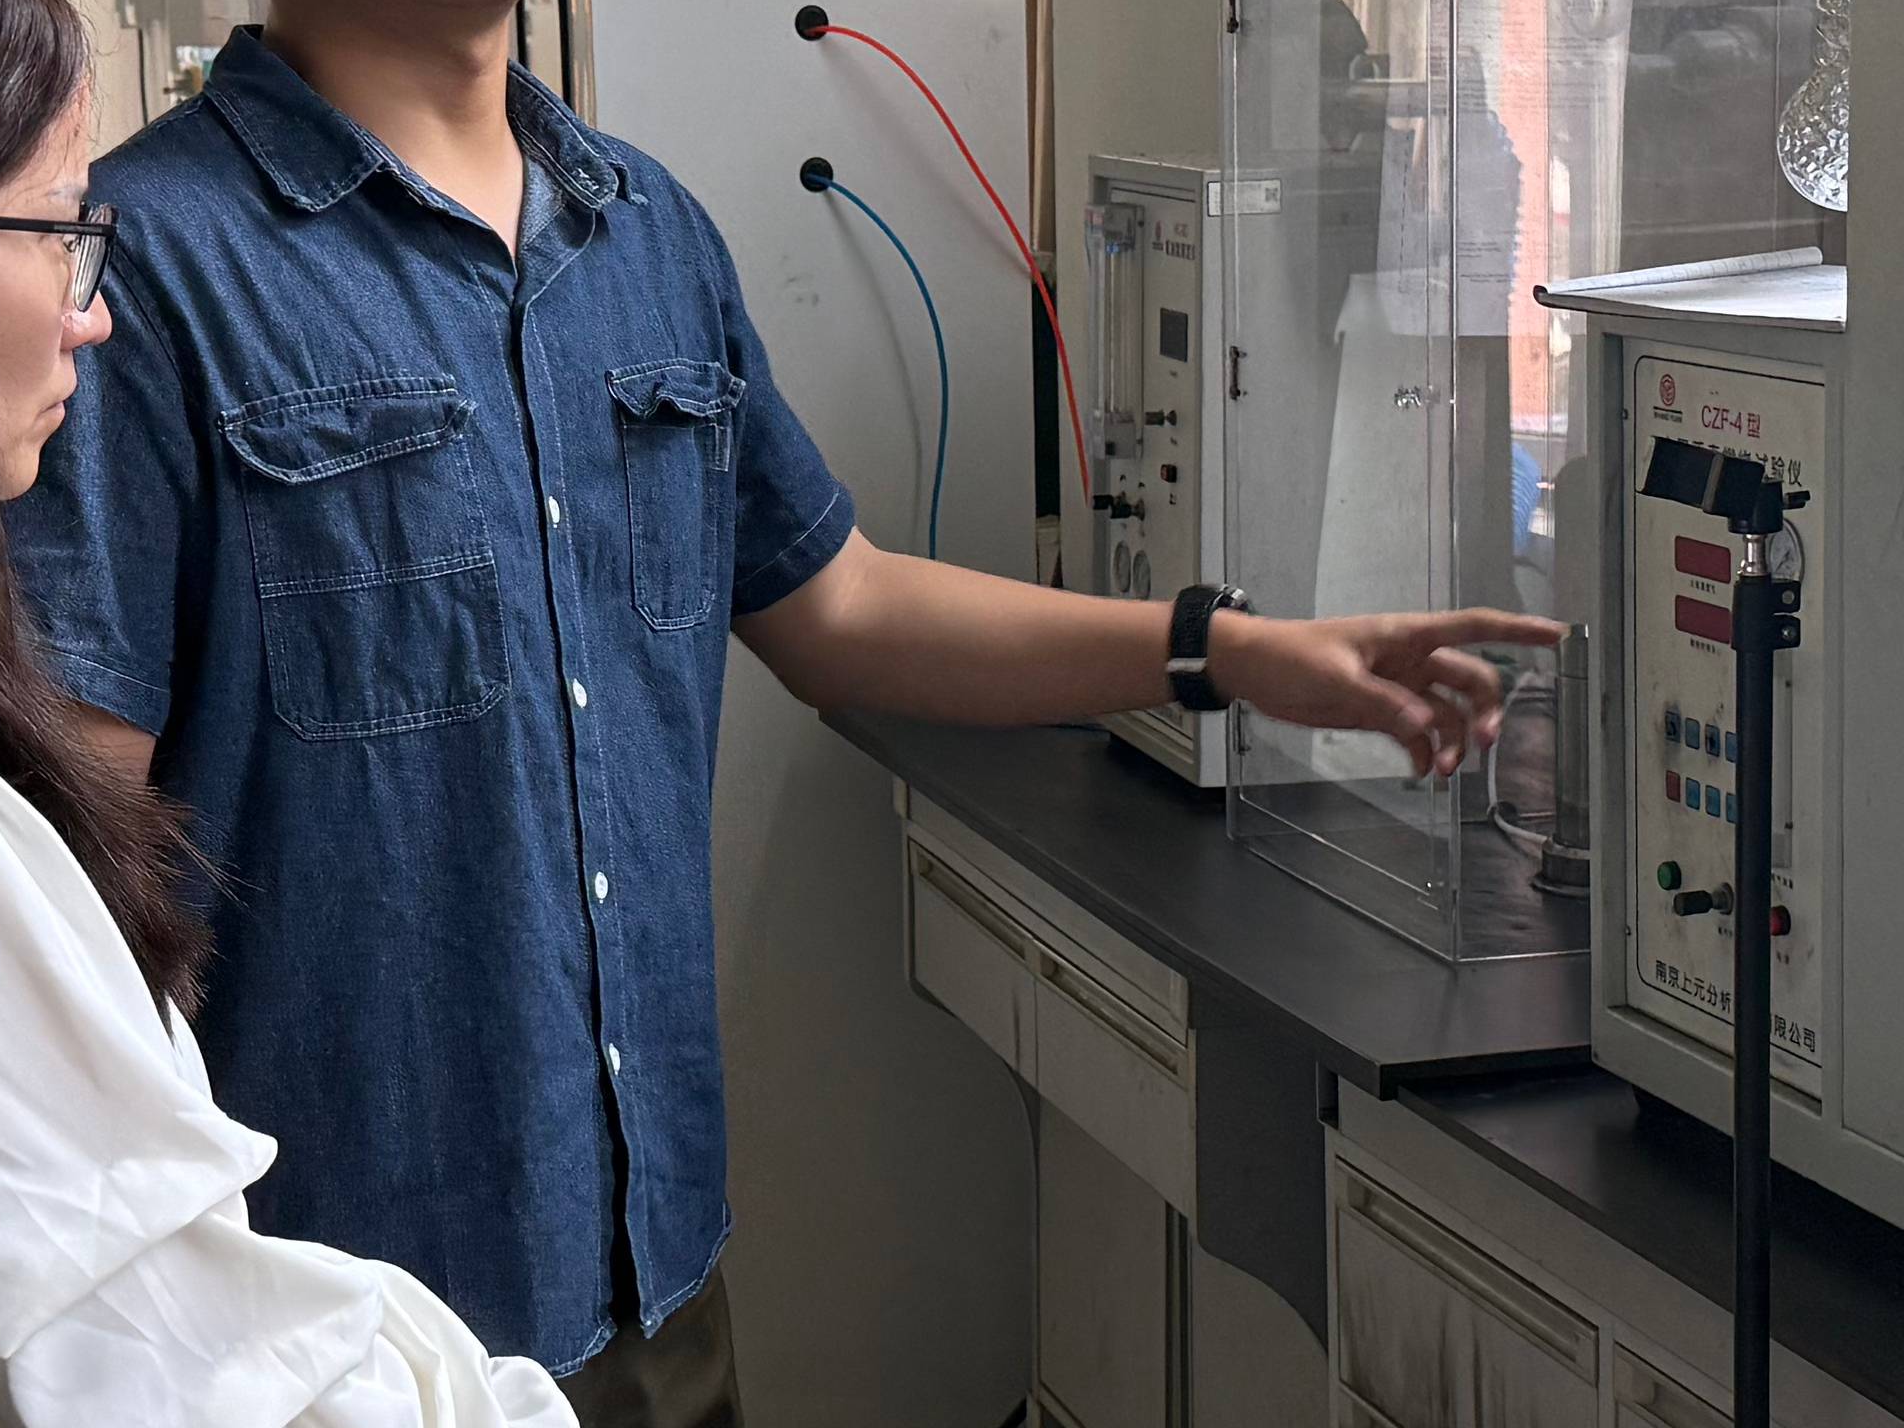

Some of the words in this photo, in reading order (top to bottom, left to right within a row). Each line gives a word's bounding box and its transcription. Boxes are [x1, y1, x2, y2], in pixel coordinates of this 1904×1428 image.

[1701, 404, 1743, 435] CZF-4
[1747, 411, 1761, 439] 型
[1655, 959, 1816, 1053] 南京上元分析限公司
